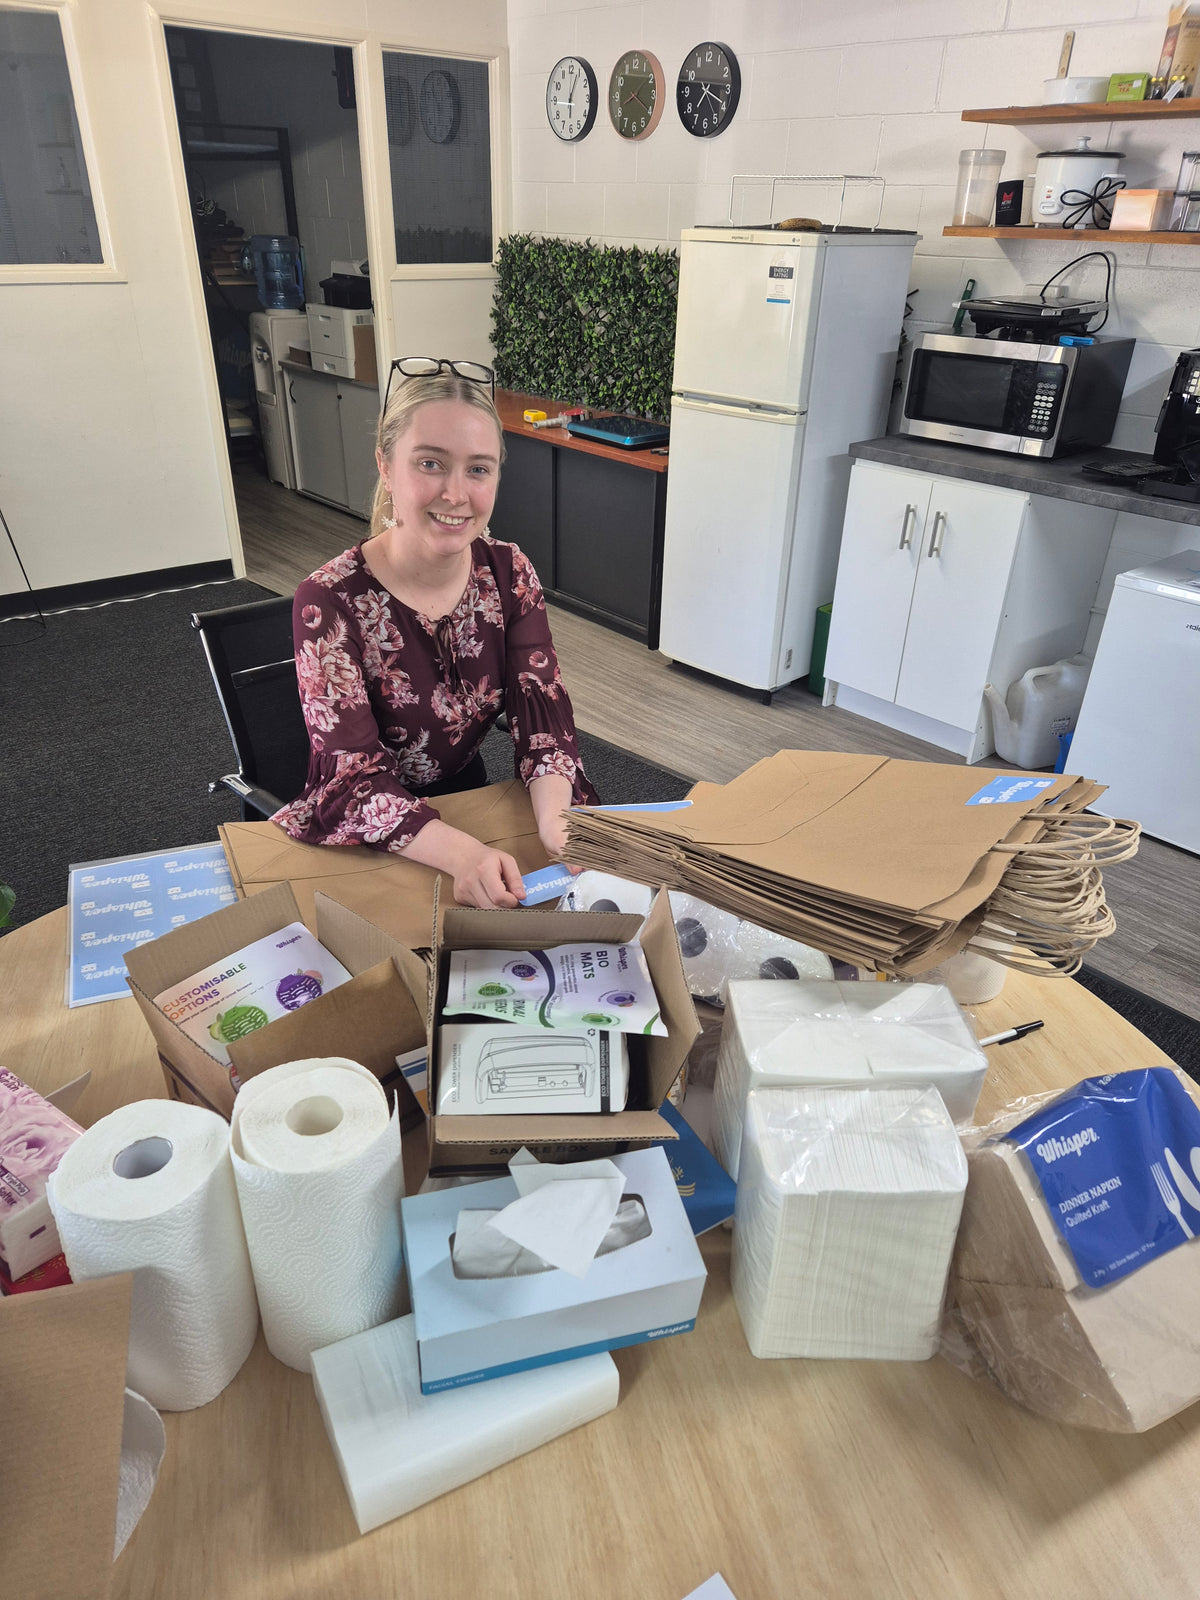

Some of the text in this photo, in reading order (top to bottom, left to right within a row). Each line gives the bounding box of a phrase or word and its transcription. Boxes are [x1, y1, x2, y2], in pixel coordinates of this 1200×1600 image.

[706, 51, 712, 62] 12
[633, 59, 639, 68] 12
[569, 65, 574, 74] 12
[723, 67, 728, 77] 2
[649, 73, 654, 83] 2
[689, 71, 695, 80] 10
[556, 82, 561, 91] 10
[583, 79, 587, 88] 2
[685, 86, 689, 97] 9
[726, 84, 730, 94] 3
[586, 94, 590, 103] 3
[615, 92, 619, 101] 9
[651, 90, 656, 99] 3
[648, 106, 652, 115] 4
[687, 103, 692, 113] 8
[721, 102, 726, 111] 4
[556, 111, 560, 119] 8
[583, 109, 587, 117] 4
[618, 107, 622, 117] 8
[624, 118, 628, 128] 7
[641, 118, 645, 127] 5
[694, 114, 698, 124] 7
[703, 118, 708, 128] 6
[713, 114, 717, 124] 5
[562, 120, 565, 130] 7
[569, 124, 573, 133] 6
[577, 120, 581, 129] 5
[632, 122, 636, 131] 6
[275, 935, 302, 949] Whisper
[596, 950, 608, 968] BIO
[581, 952, 595, 980] MATS
[162, 962, 247, 1014] CUSTOMISABLE
[169, 989, 220, 1020] OPTIONS
[513, 999, 525, 1017] RINAL
[1059, 1176, 1122, 1214] DINNER NAPKIN
[1065, 1200, 1110, 1228] Quilted Kraft
[647, 1323, 690, 1338] Whisper
